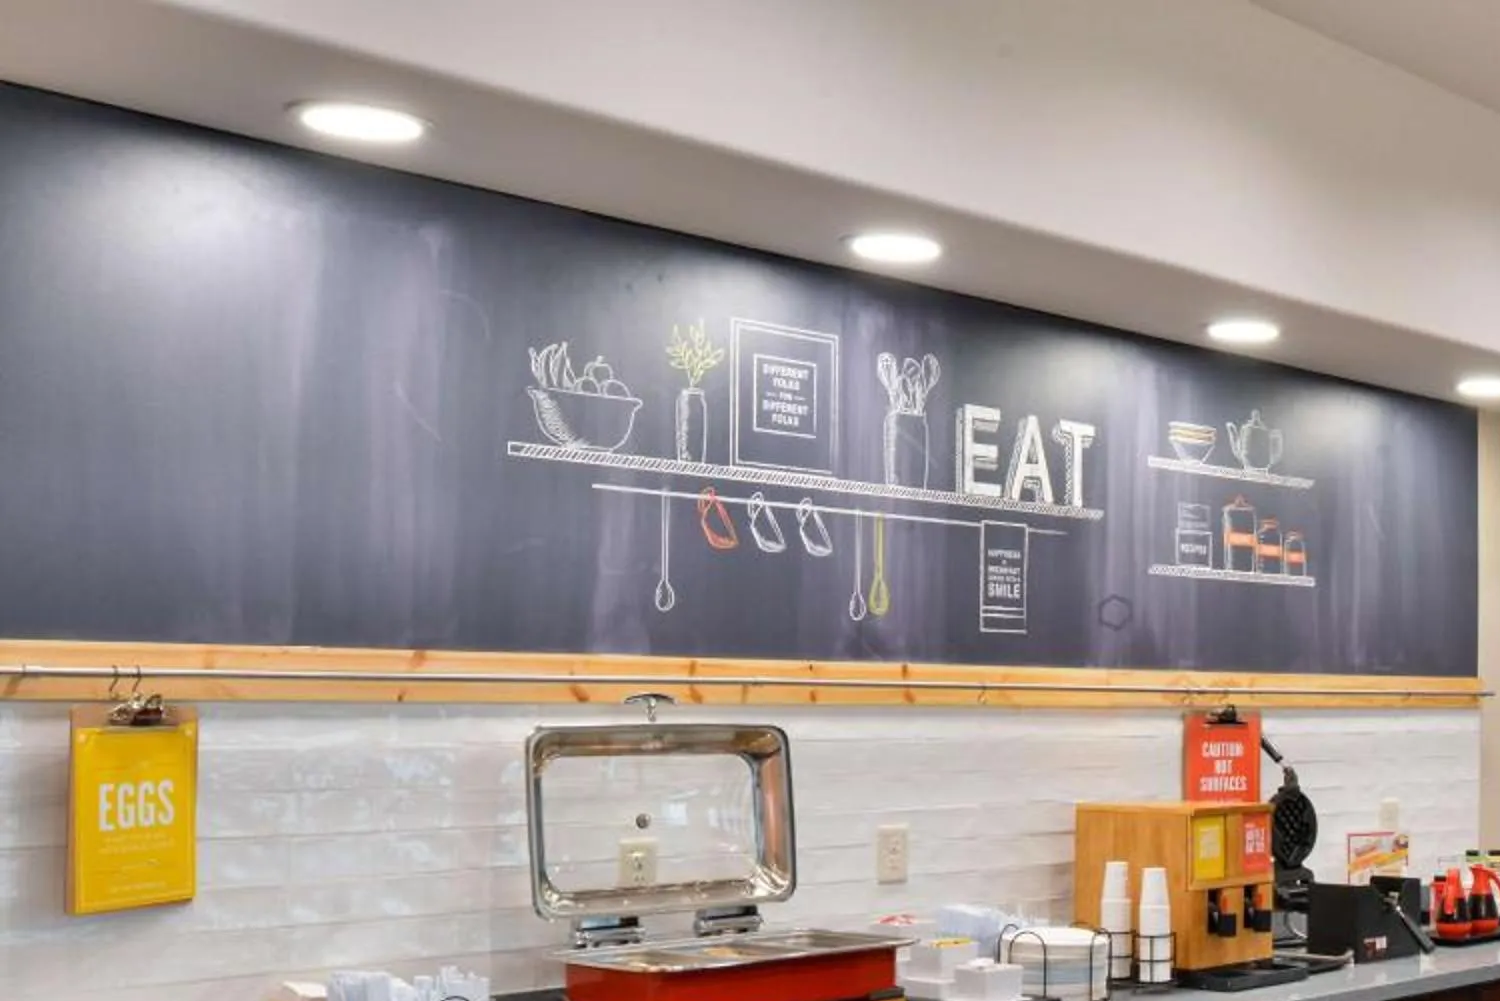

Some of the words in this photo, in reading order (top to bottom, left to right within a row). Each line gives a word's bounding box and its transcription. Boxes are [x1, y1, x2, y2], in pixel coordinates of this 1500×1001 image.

[956, 403, 1096, 508] EAT
[987, 582, 1021, 599] SMILE
[1200, 776, 1248, 792] SURFACES
[99, 779, 175, 832] EGGS
